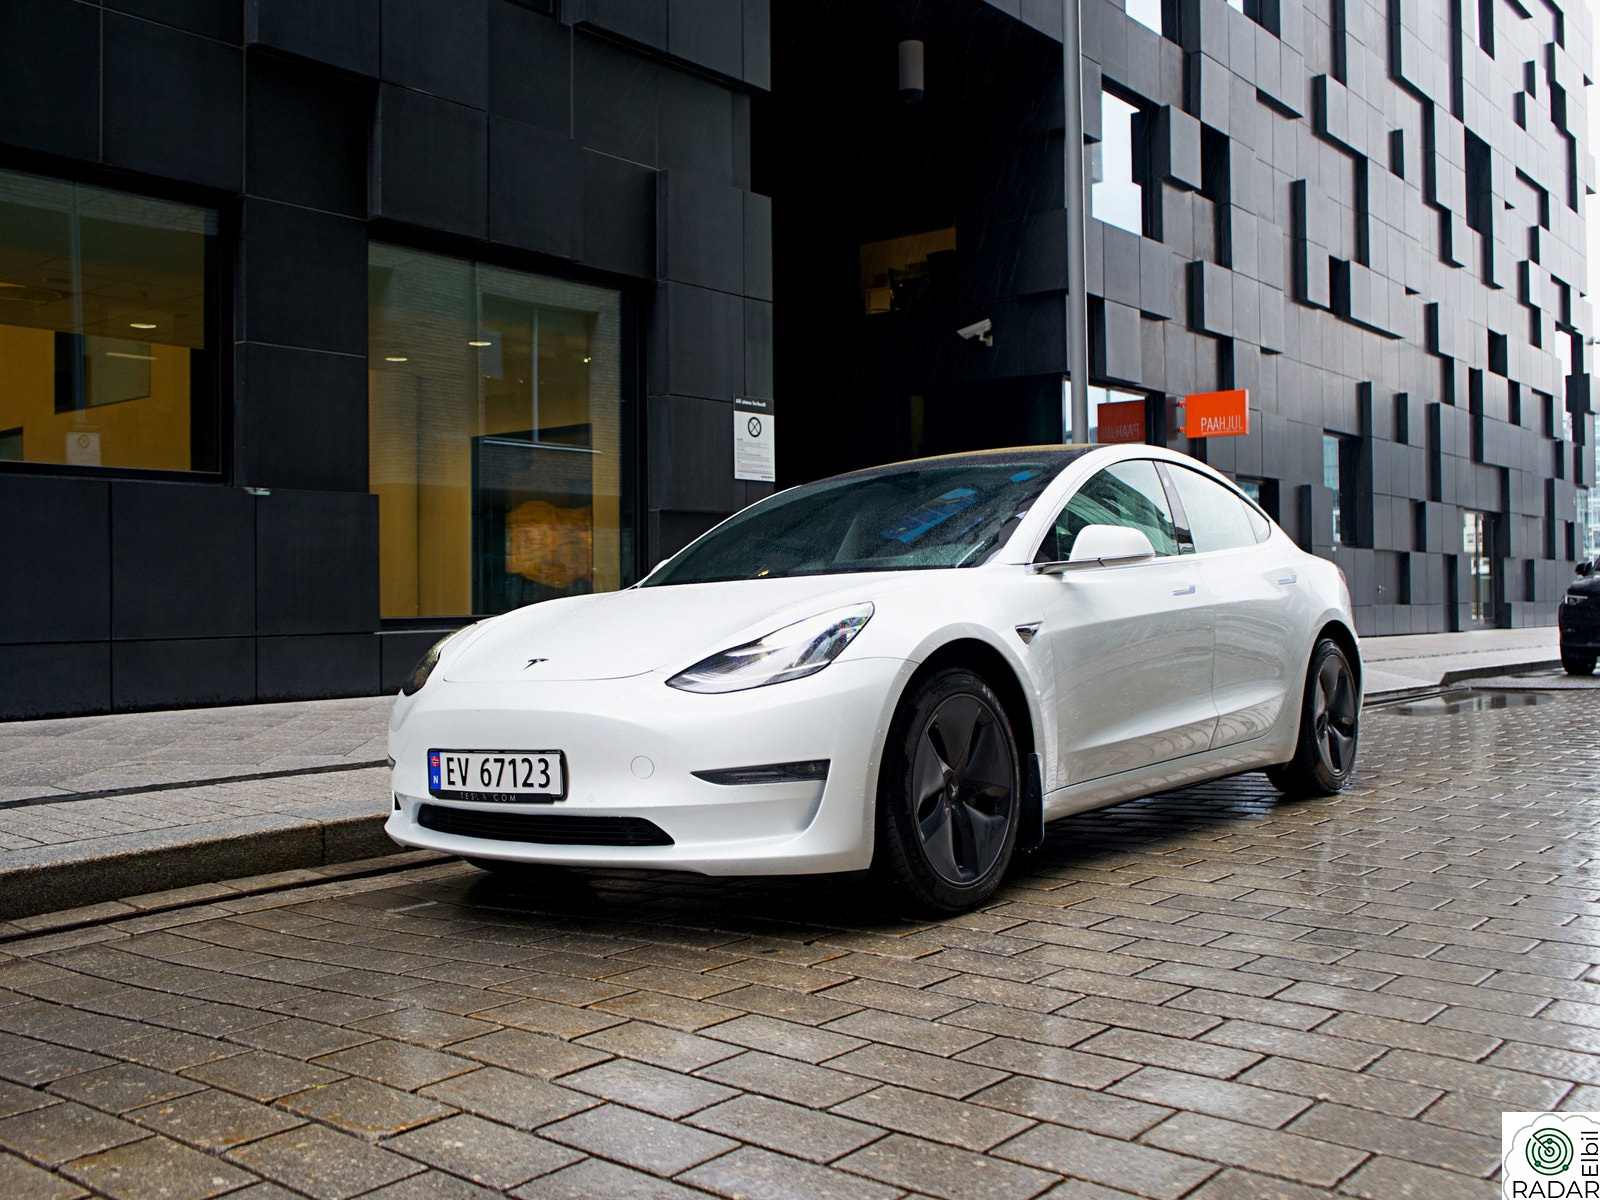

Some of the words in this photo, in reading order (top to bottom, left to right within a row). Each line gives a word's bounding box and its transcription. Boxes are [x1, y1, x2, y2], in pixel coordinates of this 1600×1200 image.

[433, 775, 439, 784] N
[446, 757, 469, 787] EV
[480, 757, 551, 789] 67123
